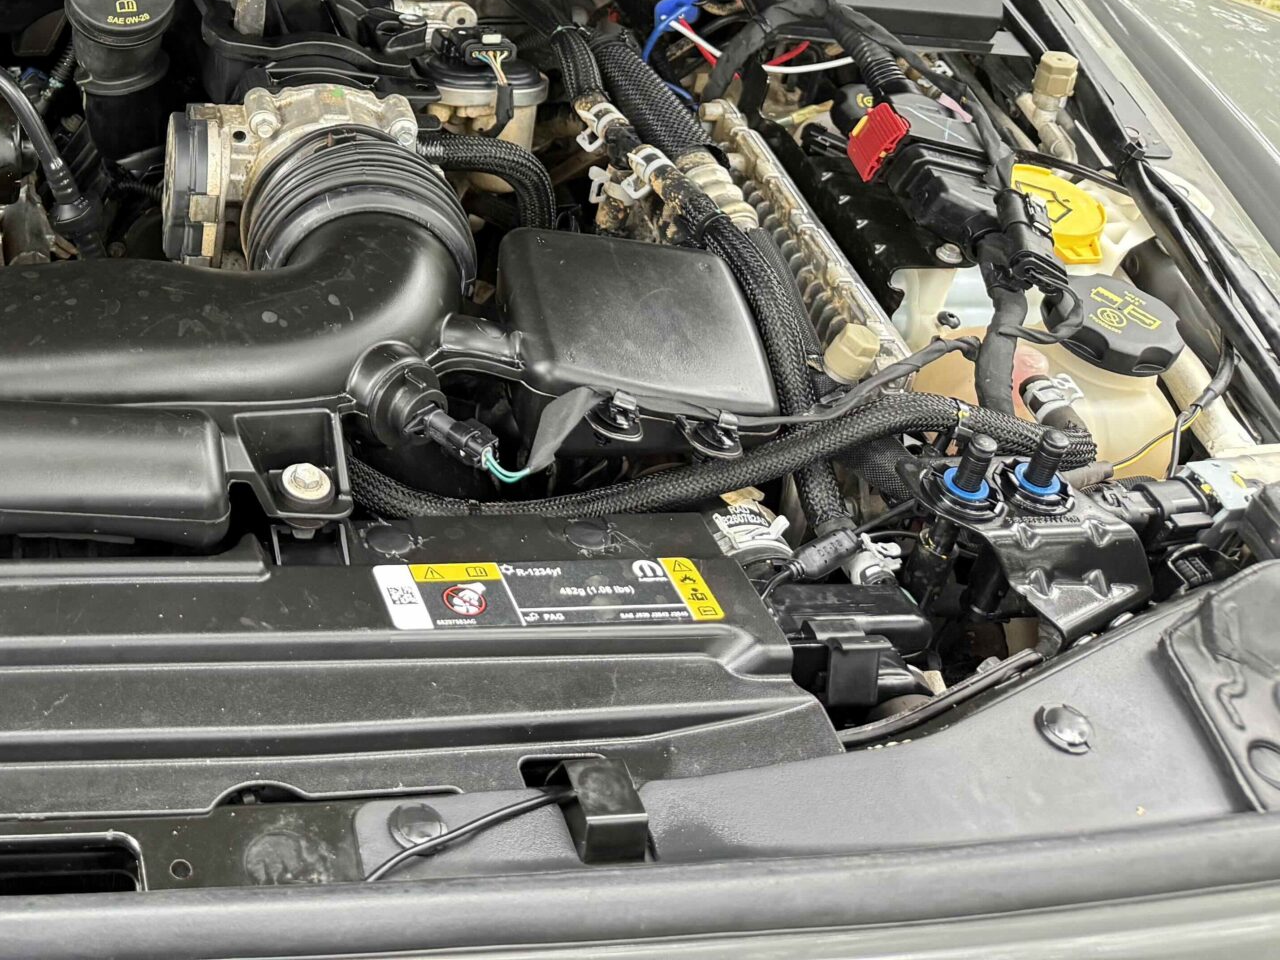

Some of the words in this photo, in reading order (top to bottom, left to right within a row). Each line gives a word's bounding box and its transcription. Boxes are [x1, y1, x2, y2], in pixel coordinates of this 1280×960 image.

[107, 15, 125, 24] SAE
[125, 13, 151, 25] 0W-20
[727, 505, 750, 514] RAD
